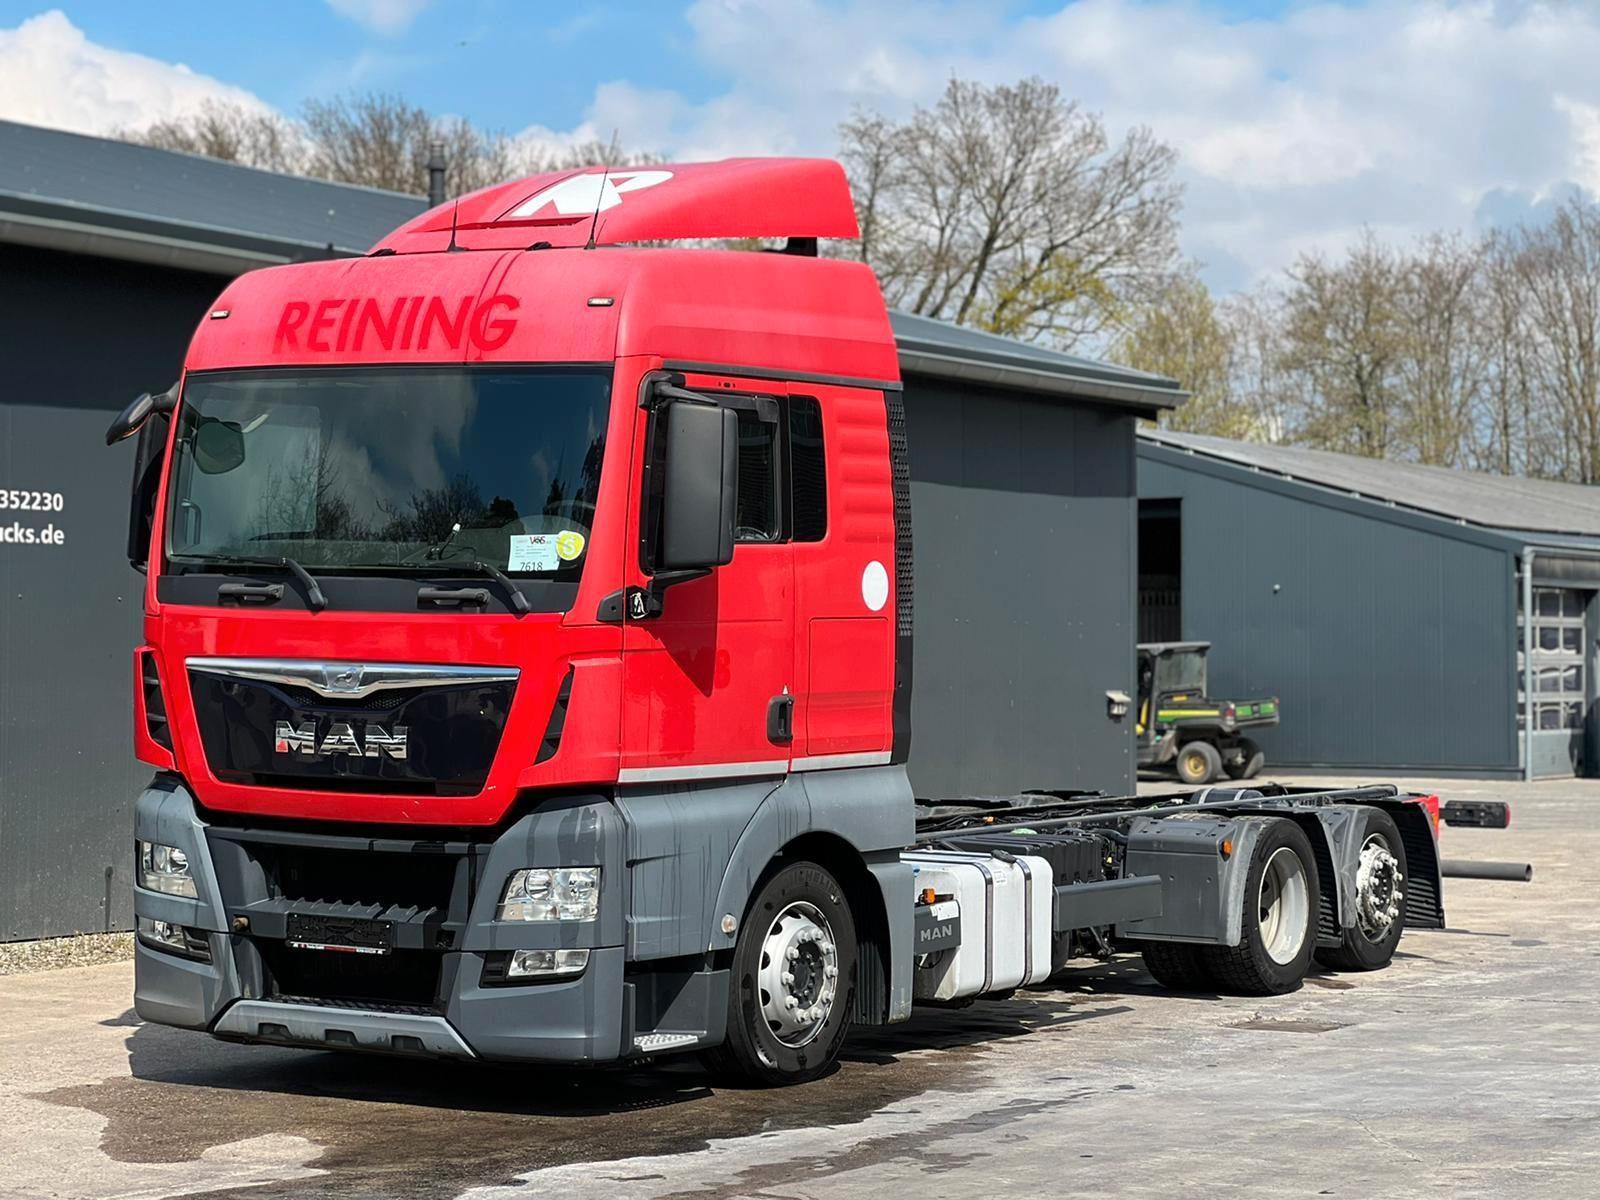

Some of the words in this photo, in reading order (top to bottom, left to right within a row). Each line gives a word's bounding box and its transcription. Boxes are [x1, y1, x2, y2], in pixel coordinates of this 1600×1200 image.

[272, 293, 520, 355] REINING
[0, 489, 64, 512] 352230
[519, 561, 543, 571] 7618
[275, 720, 409, 759] MAN
[920, 924, 953, 942] MAN
